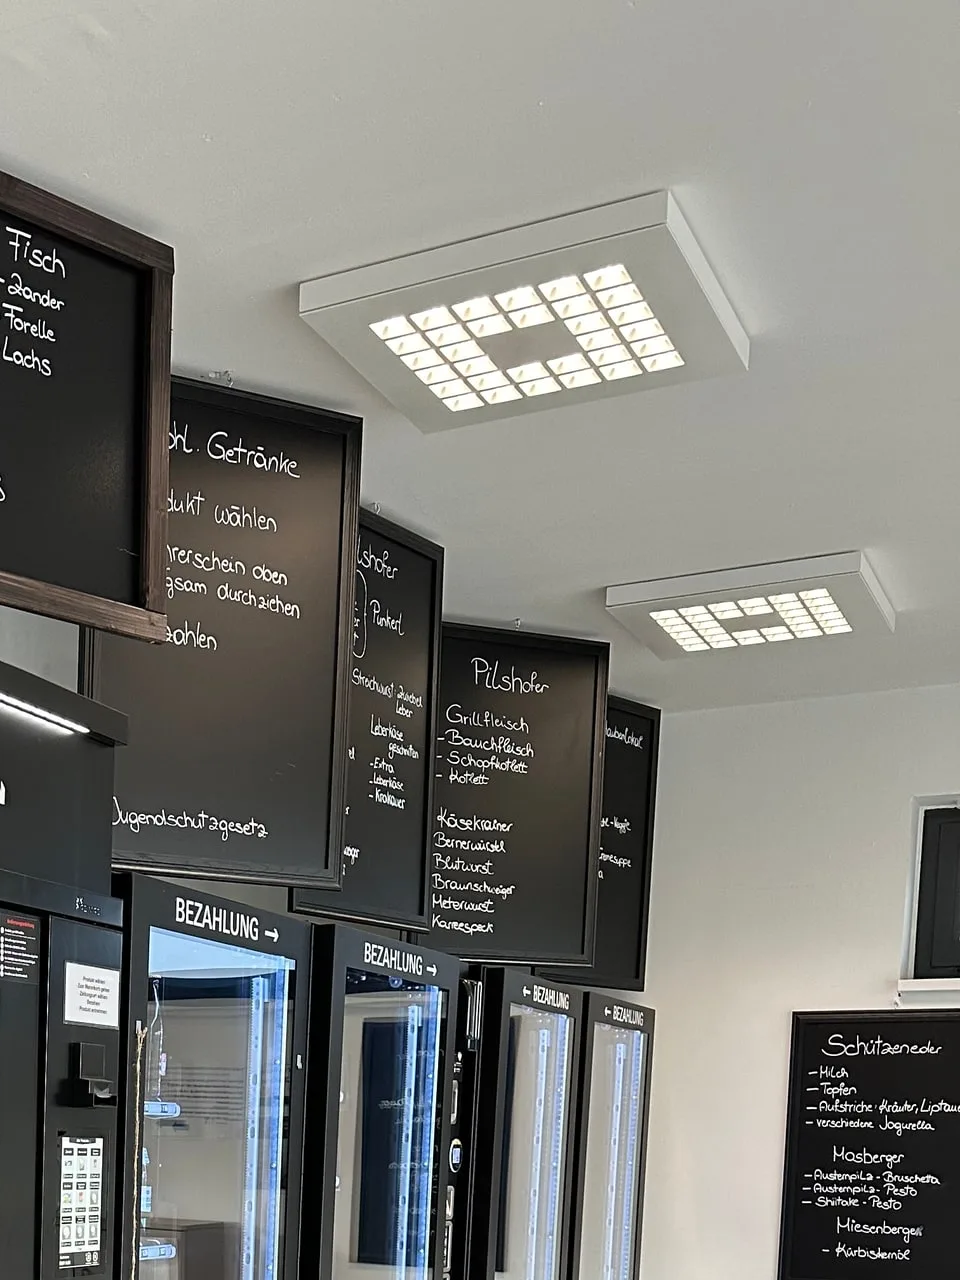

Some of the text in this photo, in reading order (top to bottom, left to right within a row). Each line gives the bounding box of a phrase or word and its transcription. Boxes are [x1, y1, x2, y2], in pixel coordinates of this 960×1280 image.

[5, 226, 66, 279] Fisch
[207, 431, 300, 479] Getränke
[215, 504, 277, 532] wählen
[252, 564, 288, 586] oben
[470, 657, 549, 694] Pilshofer
[112, 796, 269, 841] Jugendschutzgesetz
[175, 897, 259, 941] BEZAHLUNG
[364, 942, 423, 975] BEZAHLUNG
[533, 984, 570, 1010] BEZAHLUNG
[612, 1005, 644, 1026] BEZAHLUNG
[821, 1033, 943, 1057] Schützeneder
